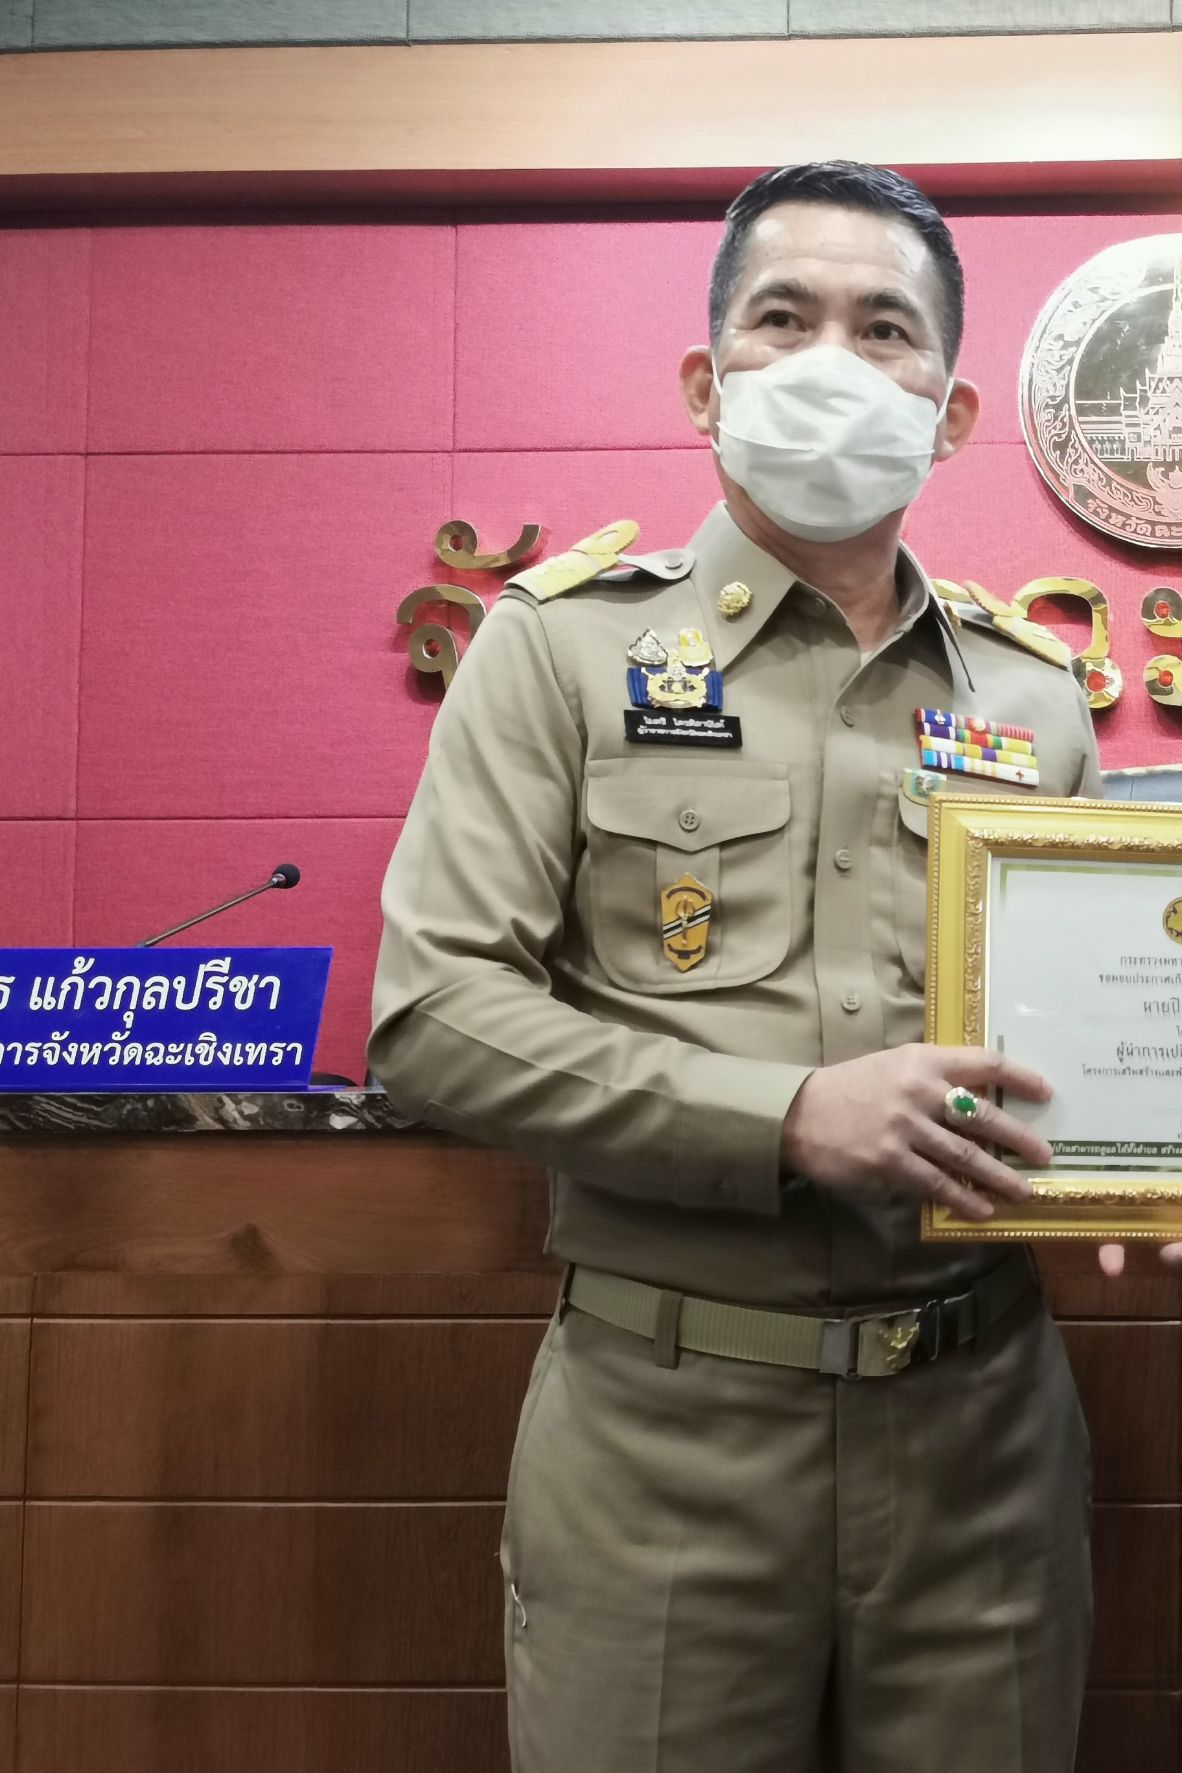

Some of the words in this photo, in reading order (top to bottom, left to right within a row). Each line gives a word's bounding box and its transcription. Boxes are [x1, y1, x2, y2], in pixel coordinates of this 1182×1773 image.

[29, 956, 281, 1029] แก้วกุลปรีชา
